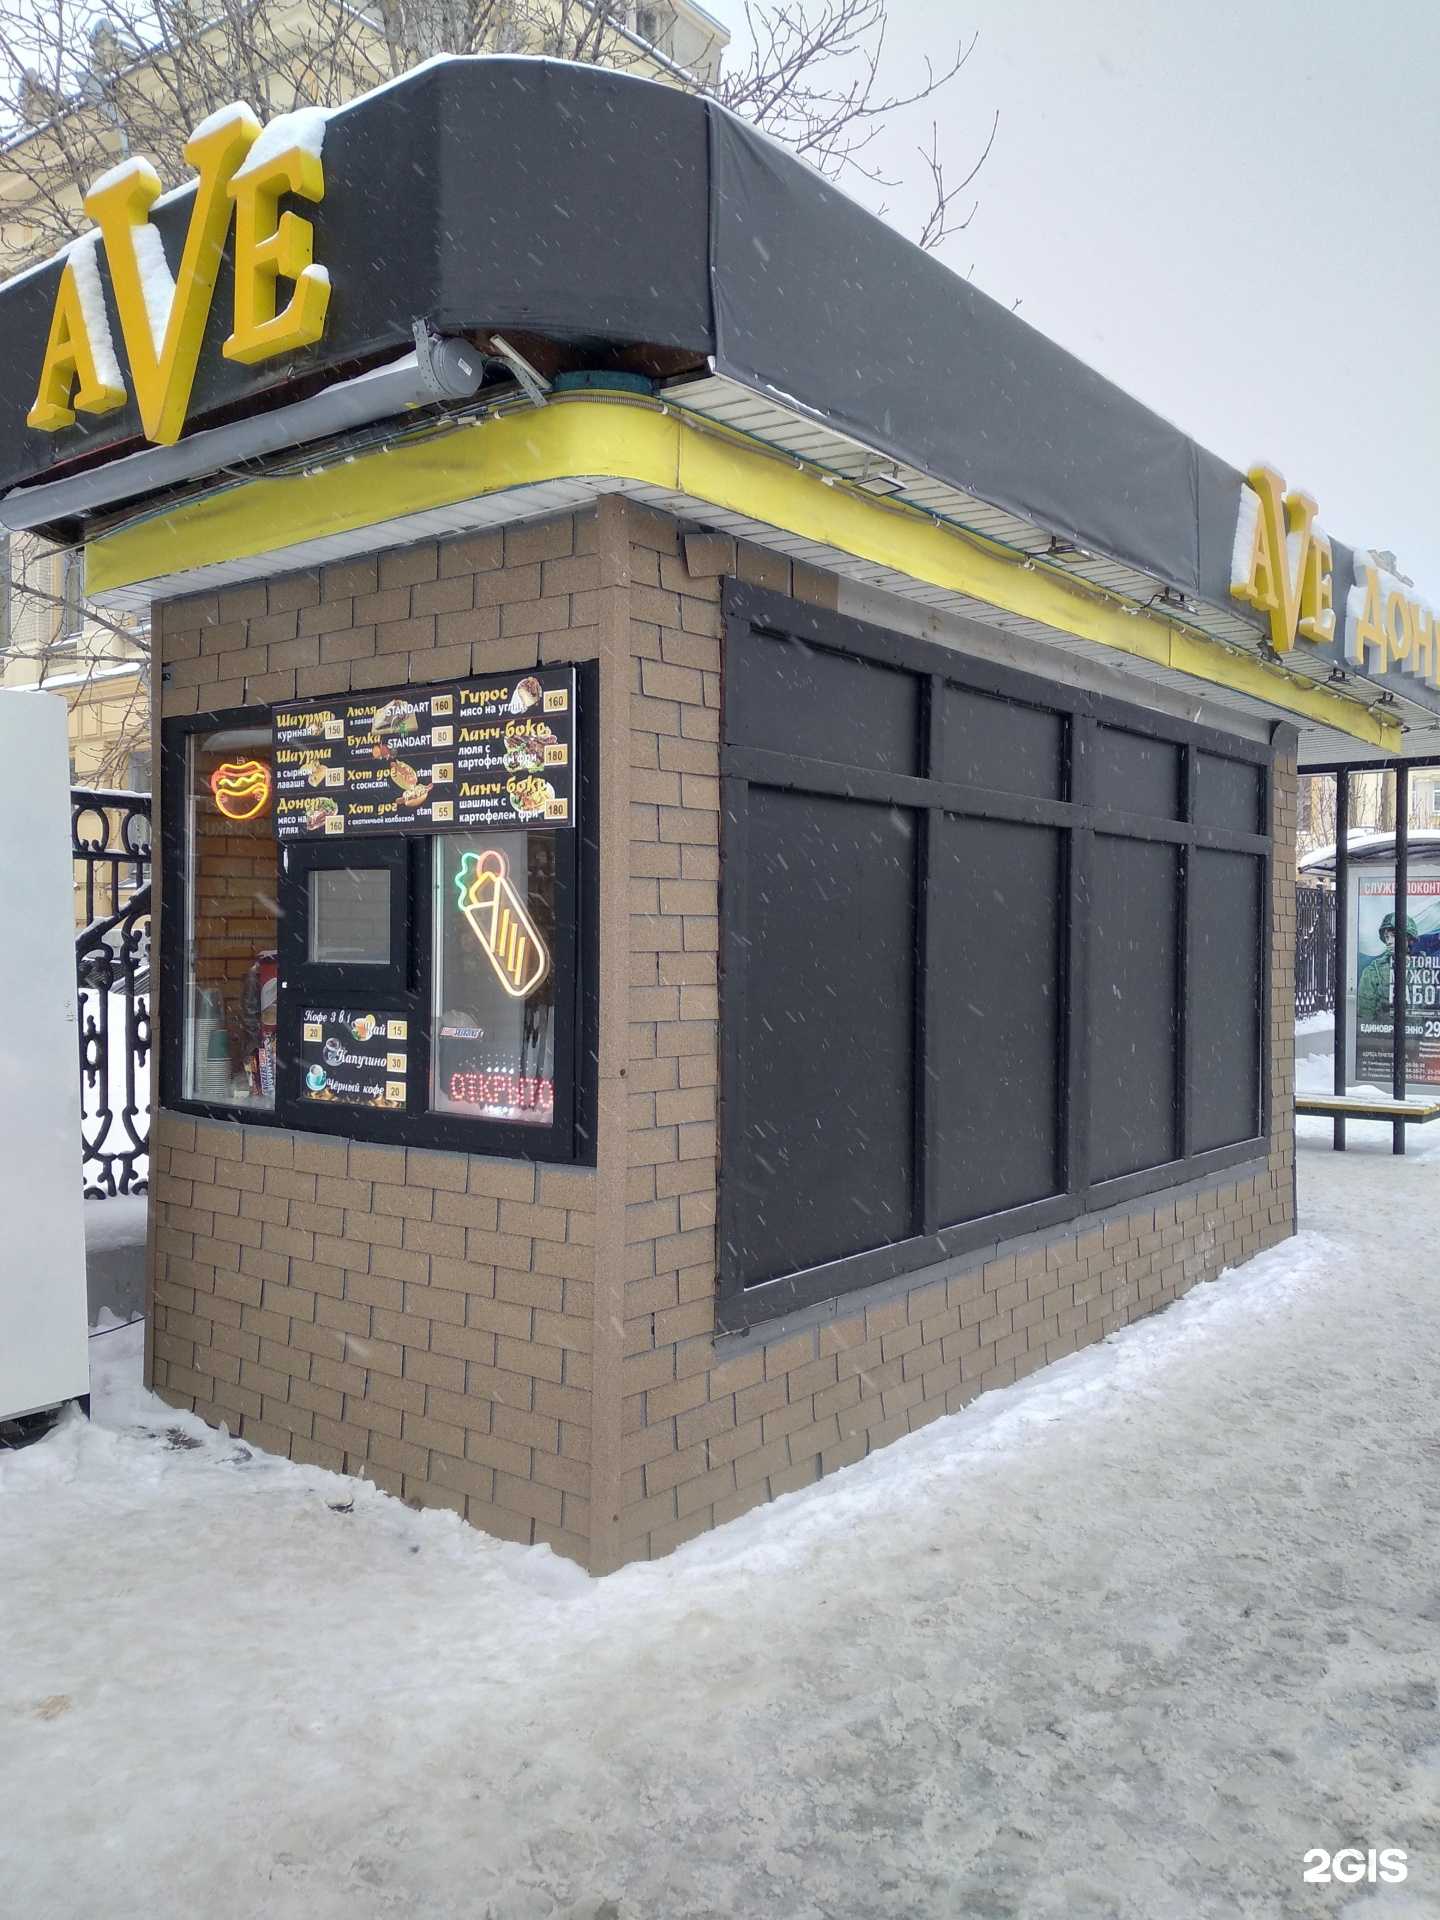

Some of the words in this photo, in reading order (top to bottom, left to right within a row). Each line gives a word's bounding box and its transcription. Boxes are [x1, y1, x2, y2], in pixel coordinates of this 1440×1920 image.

[27, 112, 331, 446] AVE
[1231, 465, 1337, 653] AVE
[460, 688, 508, 705] Гирос
[548, 696, 564, 707] 160
[347, 706, 377, 717] Люля
[385, 702, 429, 716] STANDART
[435, 701, 449, 711] 160
[460, 705, 483, 717] мясо
[485, 704, 496, 713] на
[276, 711, 332, 729] Шаурма
[347, 732, 381, 748] Булка
[387, 734, 431, 749] STANDART
[276, 747, 332, 765] Шаурма
[548, 751, 563, 761] 180
[347, 770, 372, 780] Хот
[348, 803, 374, 814] Хот
[378, 802, 398, 814] дог
[459, 798, 498, 808] шашлык
[438, 807, 448, 816] 55
[548, 805, 563, 815] 180
[278, 816, 296, 825] мясо
[459, 808, 516, 824] картофелем
[330, 821, 343, 831] 160
[278, 827, 299, 838] углях
[303, 1010, 327, 1024] Кофе
[310, 1029, 318, 1037] 20
[393, 1026, 402, 1035] 15
[392, 1059, 400, 1067] 30
[362, 1083, 384, 1097] кофе
[391, 1087, 400, 1096] 20
[450, 1072, 555, 1109] ОТКРЫТО
